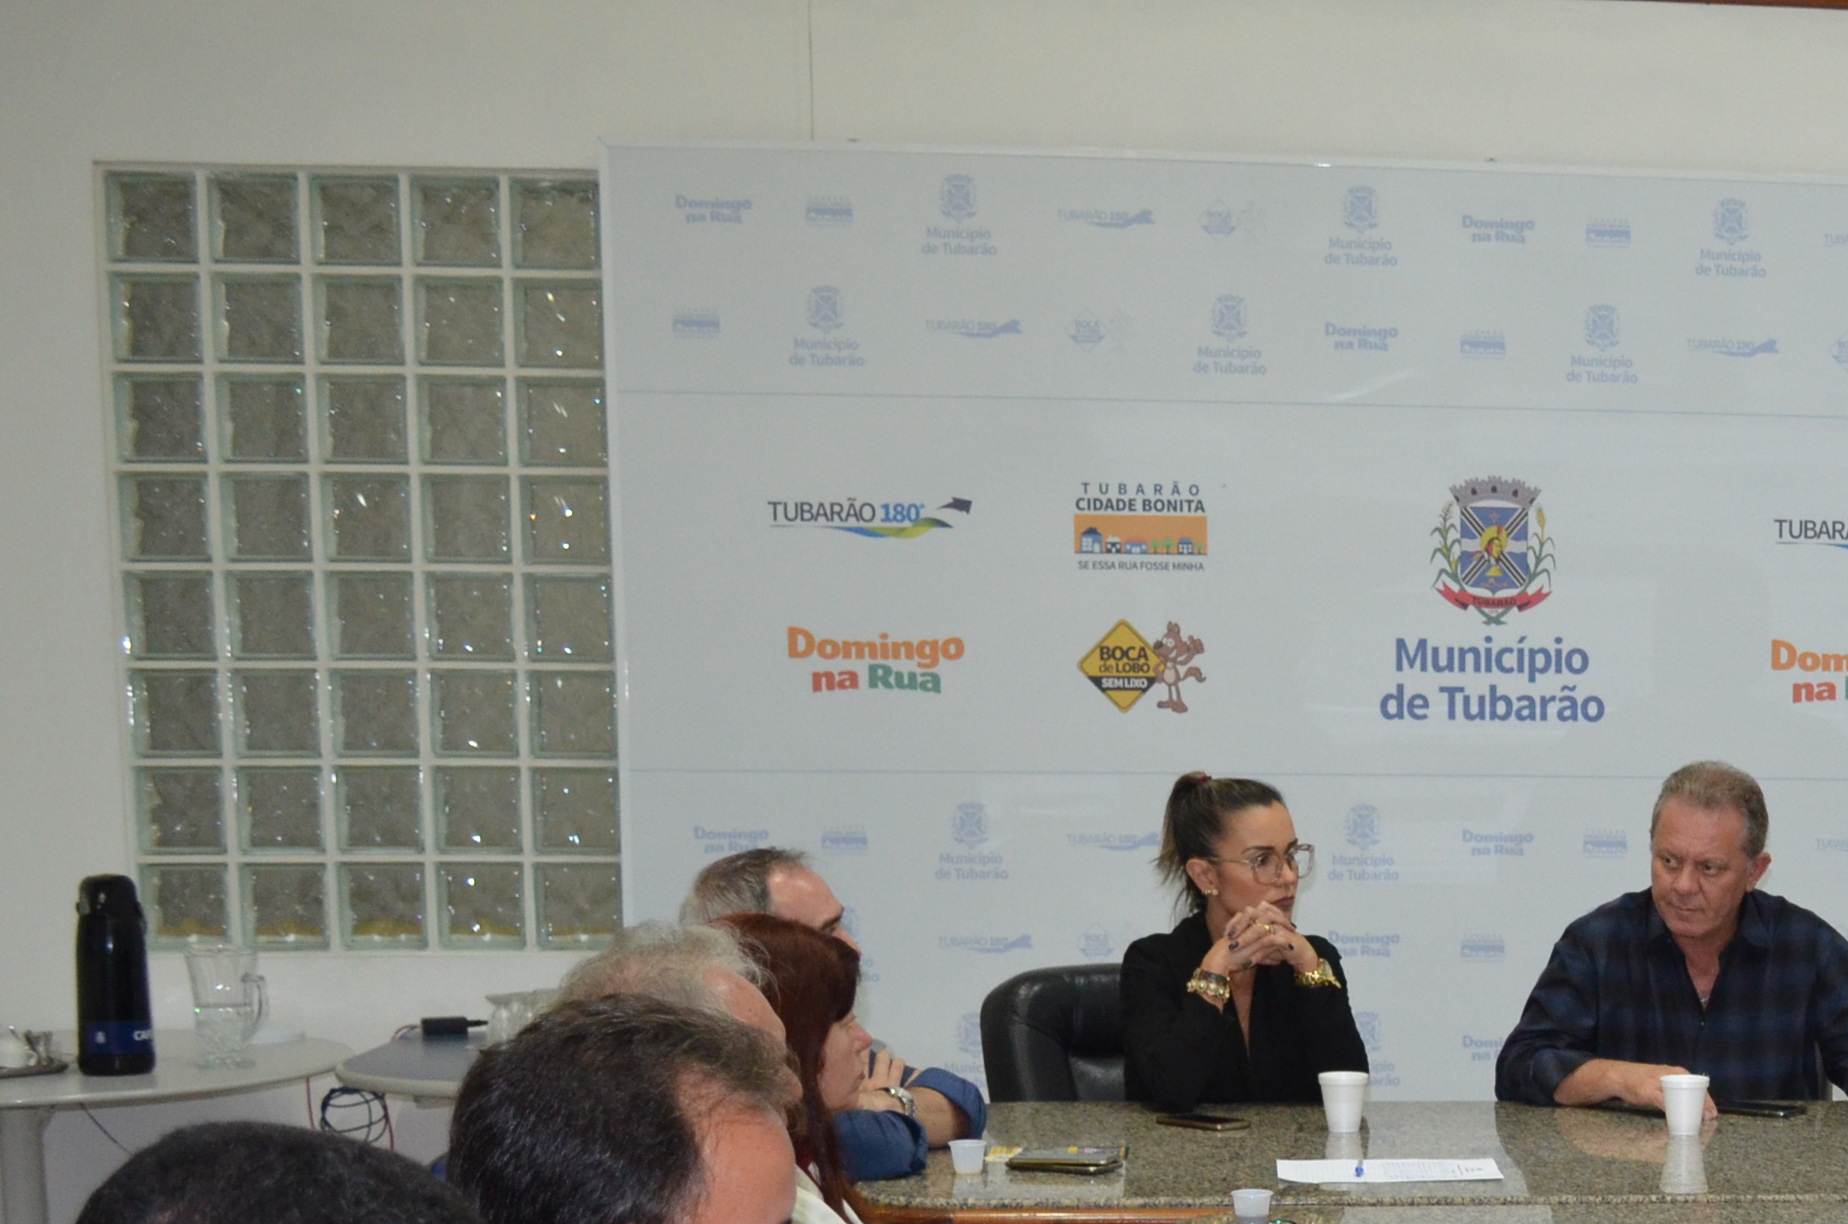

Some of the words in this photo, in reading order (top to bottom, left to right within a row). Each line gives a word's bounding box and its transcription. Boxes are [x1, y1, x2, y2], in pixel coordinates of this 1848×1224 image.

[1081, 481, 1200, 496] TUBARÃO
[768, 498, 876, 523] TUBARÃO
[1075, 498, 1137, 512] CIDADE
[1142, 498, 1205, 513] BONITA
[1078, 560, 1090, 570] SE
[1092, 561, 1116, 570] ESSA
[1118, 561, 1138, 570] RUA
[1140, 562, 1170, 571] FOSSE
[1172, 562, 1204, 572] MINHA
[787, 626, 964, 668] Domingo
[1100, 646, 1149, 662] BOCA
[1098, 662, 1114, 673] de
[1116, 662, 1150, 674] LOBO
[1396, 636, 1590, 683] Município
[812, 668, 859, 693] na
[868, 664, 942, 694] Rua
[1101, 677, 1122, 689] SEM
[1124, 677, 1148, 689] LIXO
[1792, 680, 1837, 704] na
[1380, 684, 1430, 720] de
[1438, 684, 1605, 722] Tubarão
